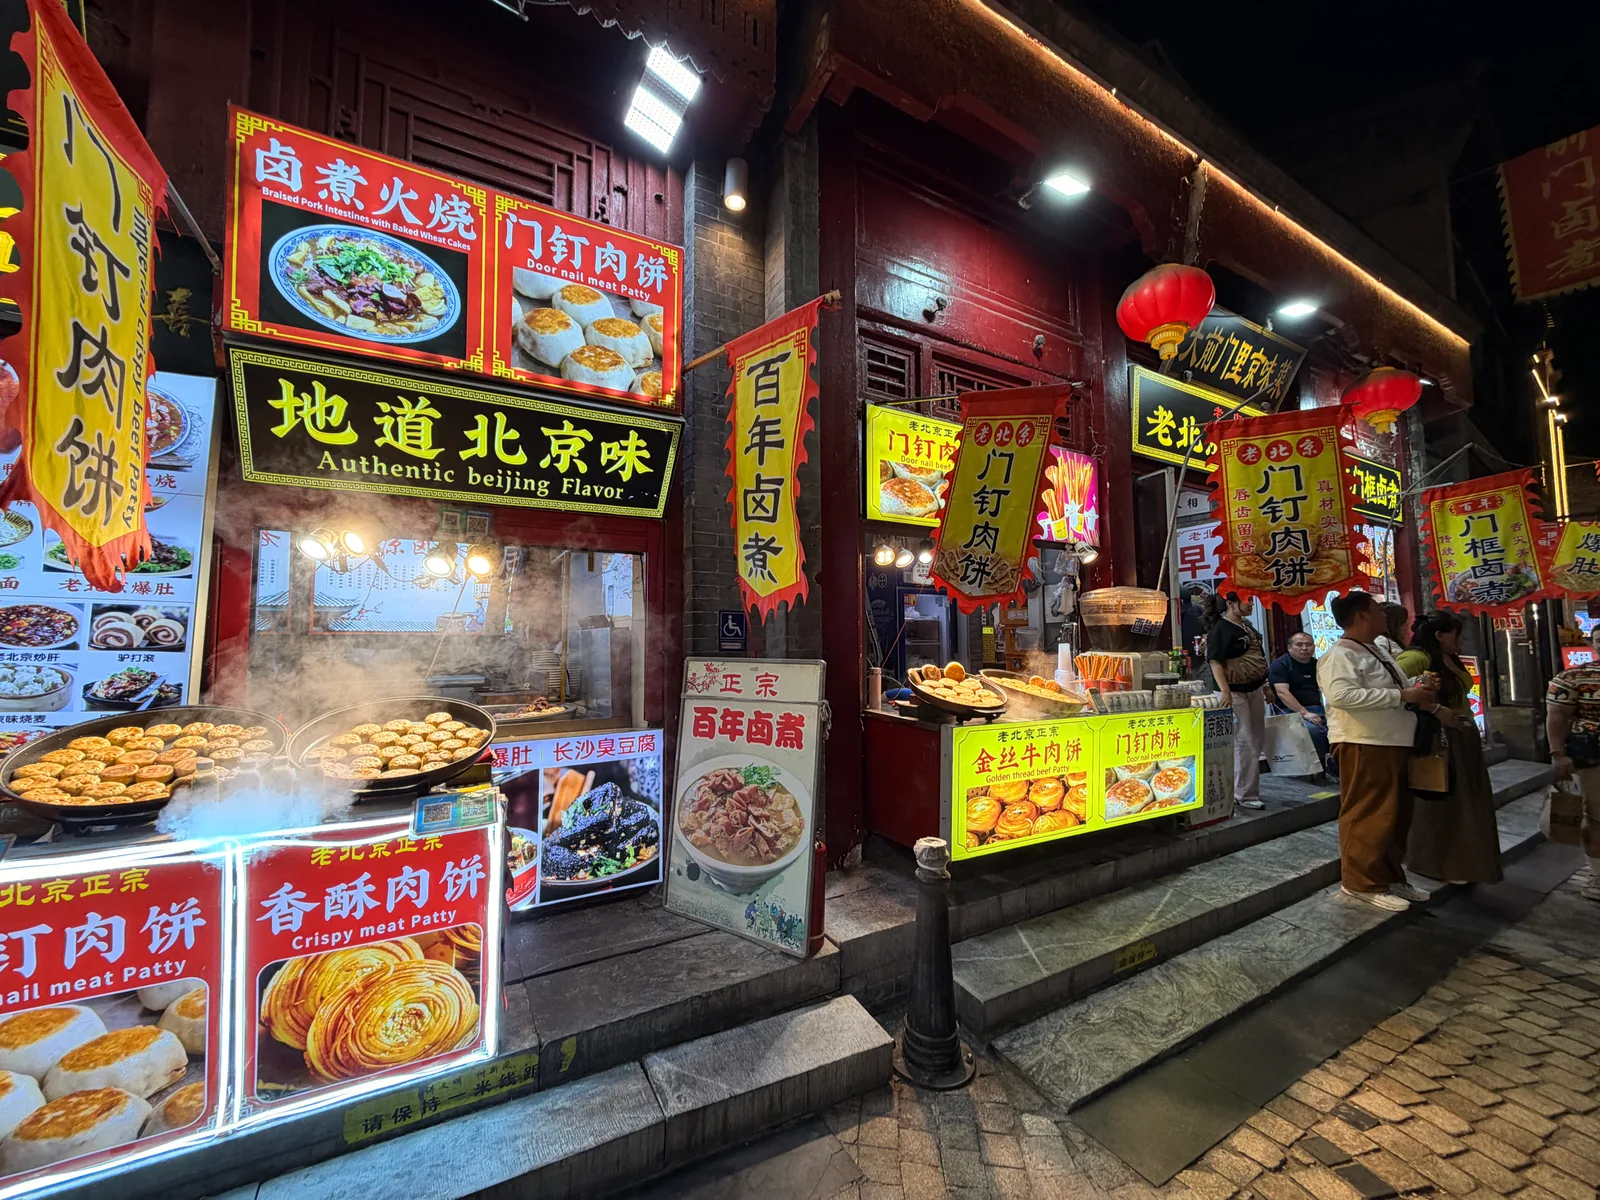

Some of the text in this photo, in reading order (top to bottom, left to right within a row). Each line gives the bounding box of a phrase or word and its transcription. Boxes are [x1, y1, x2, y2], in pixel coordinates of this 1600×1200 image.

[255, 138, 477, 240] 卤煮火烧
[262, 186, 471, 251] Braised Pork Intestines with Baked Wheat Cakes
[129, 205, 150, 318] imperial
[505, 212, 668, 293] 门钉肉饼
[527, 259, 650, 302] Door nail meat Patty
[56, 93, 131, 527] 门钉肉饼
[130, 317, 147, 395] crispy
[130, 399, 143, 457] beef
[267, 378, 654, 483] 地道北京味
[909, 420, 958, 438] 老北京正
[976, 424, 1033, 446] 老北京
[1146, 405, 1217, 456] 老北
[742, 351, 792, 584] 百年卤煮
[901, 455, 918, 464] Door
[921, 459, 933, 467] nail
[1242, 439, 1318, 462] 老北京
[317, 451, 624, 500] Authentic beijing Flavor
[958, 448, 1014, 588] 门钉肉饼
[1233, 488, 1255, 554] 唇齿留香
[1256, 464, 1315, 587] 门钉肉饼
[1317, 479, 1340, 547] 真材实料
[1459, 498, 1492, 512] 百年
[1459, 514, 1514, 601] 门框卤煮
[719, 672, 780, 697] 正宗
[0, 714, 46, 724] 味烧麦
[692, 706, 806, 750] 百年卤煮
[998, 726, 1060, 743] 老北京正宗
[1128, 715, 1174, 729] 老北京正宗
[1204, 714, 1233, 739] 京酸奶
[553, 734, 655, 762] 长沙臭豆腐
[971, 737, 1083, 775] 金丝牛肉饼
[1116, 727, 1181, 756] 门钉肉饼
[986, 765, 1070, 783] Golden thread beef Patty
[311, 835, 443, 866] 老北京正宗
[0, 868, 150, 907] 北京正宗
[256, 854, 486, 935] 香酥肉饼
[292, 910, 456, 950] Crispy meat Patty
[50, 972, 114, 996] meat
[123, 960, 186, 983] Patty
